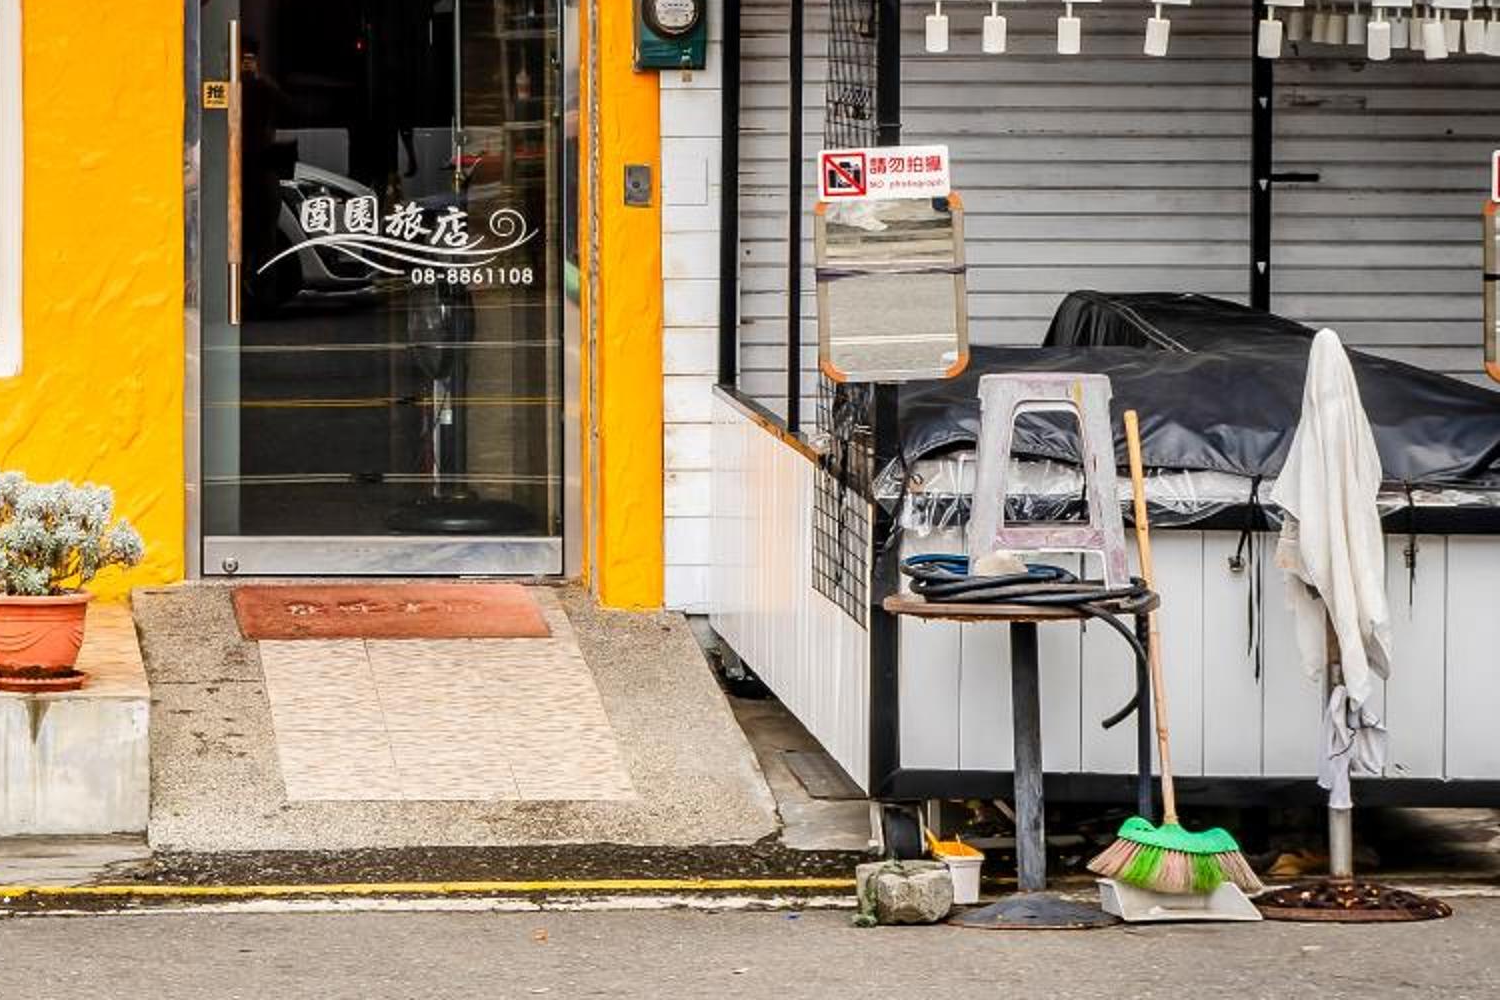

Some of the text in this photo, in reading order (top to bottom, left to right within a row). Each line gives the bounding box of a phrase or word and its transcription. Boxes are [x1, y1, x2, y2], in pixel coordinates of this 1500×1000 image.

[869, 155, 943, 175] 請勿拍攝
[410, 267, 534, 285] 08-8861108
